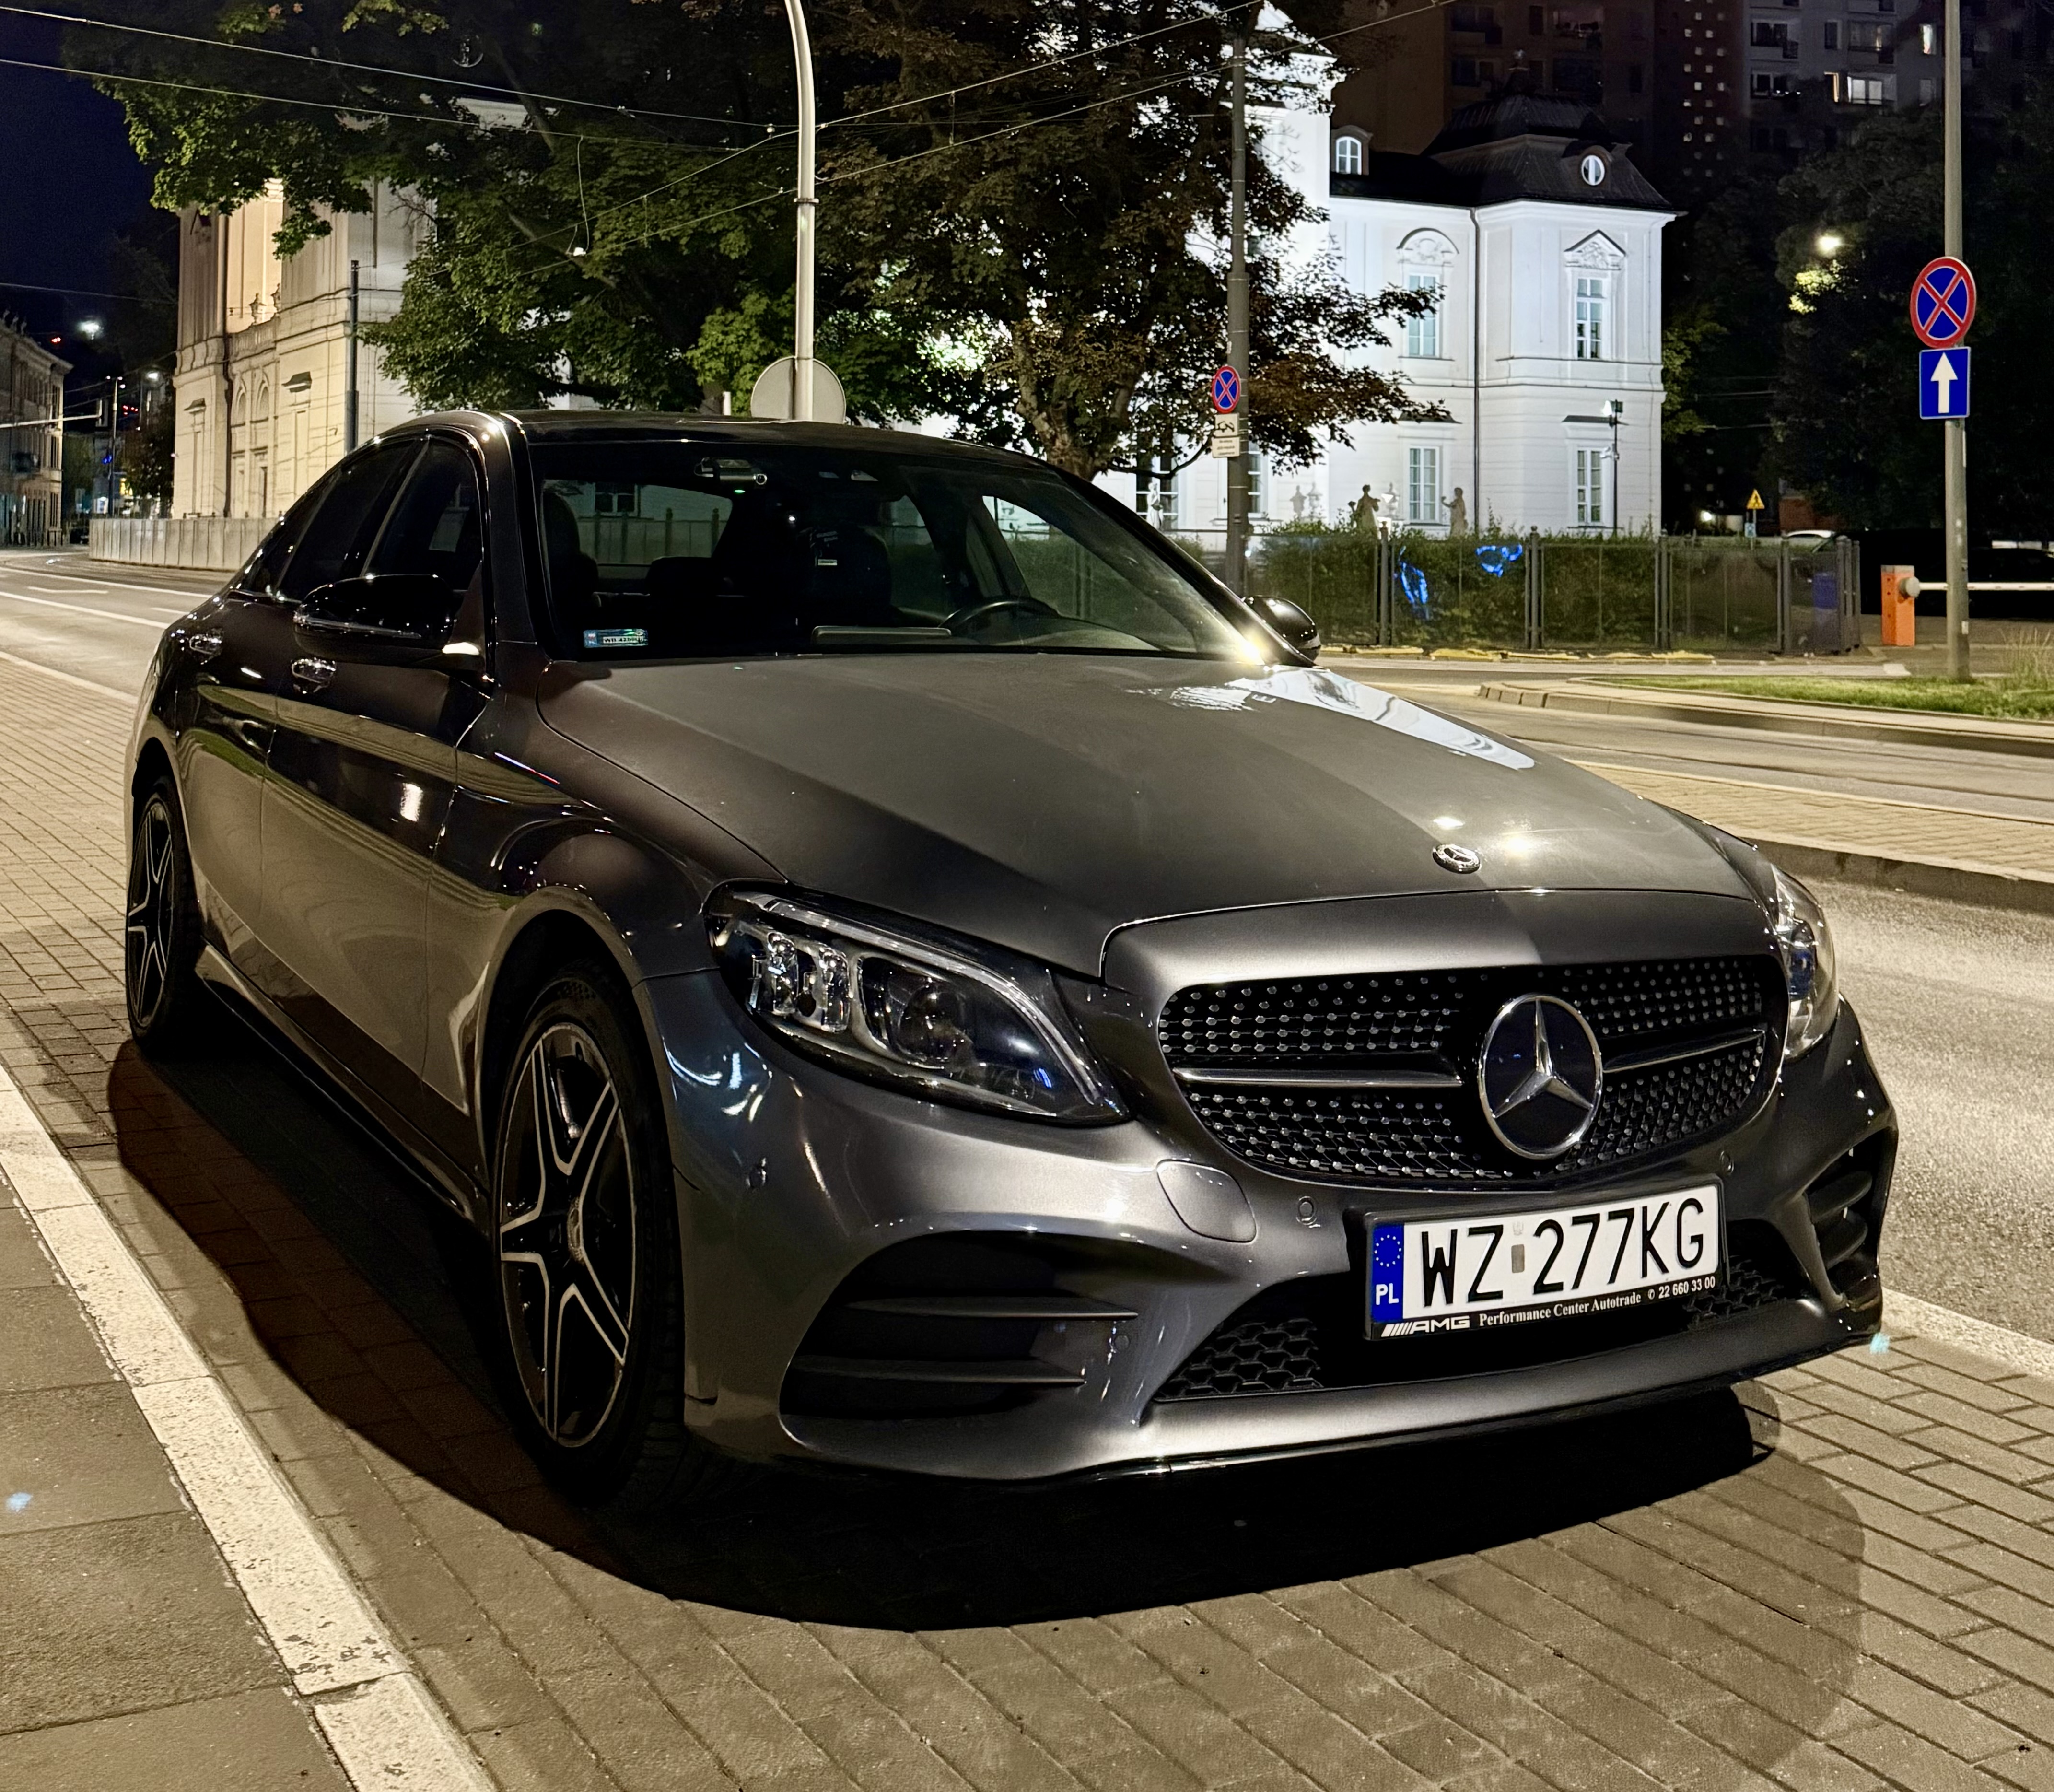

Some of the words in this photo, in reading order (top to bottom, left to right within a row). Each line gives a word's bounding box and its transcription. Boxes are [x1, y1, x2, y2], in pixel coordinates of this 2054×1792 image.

[1421, 1224, 1504, 1307] WZ
[1533, 1198, 1704, 1294] 277KG
[1376, 1283, 1399, 1305] PL
[1409, 1315, 1470, 1335] AMG
[1479, 1307, 1551, 1327] Performance
[1553, 1301, 1589, 1317] Center
[1591, 1292, 1642, 1312] Autotrade
[1658, 1285, 1670, 1299] 22
[1672, 1281, 1689, 1296] 660
[1691, 1278, 1702, 1292] 33
[1704, 1276, 1716, 1289] 00
